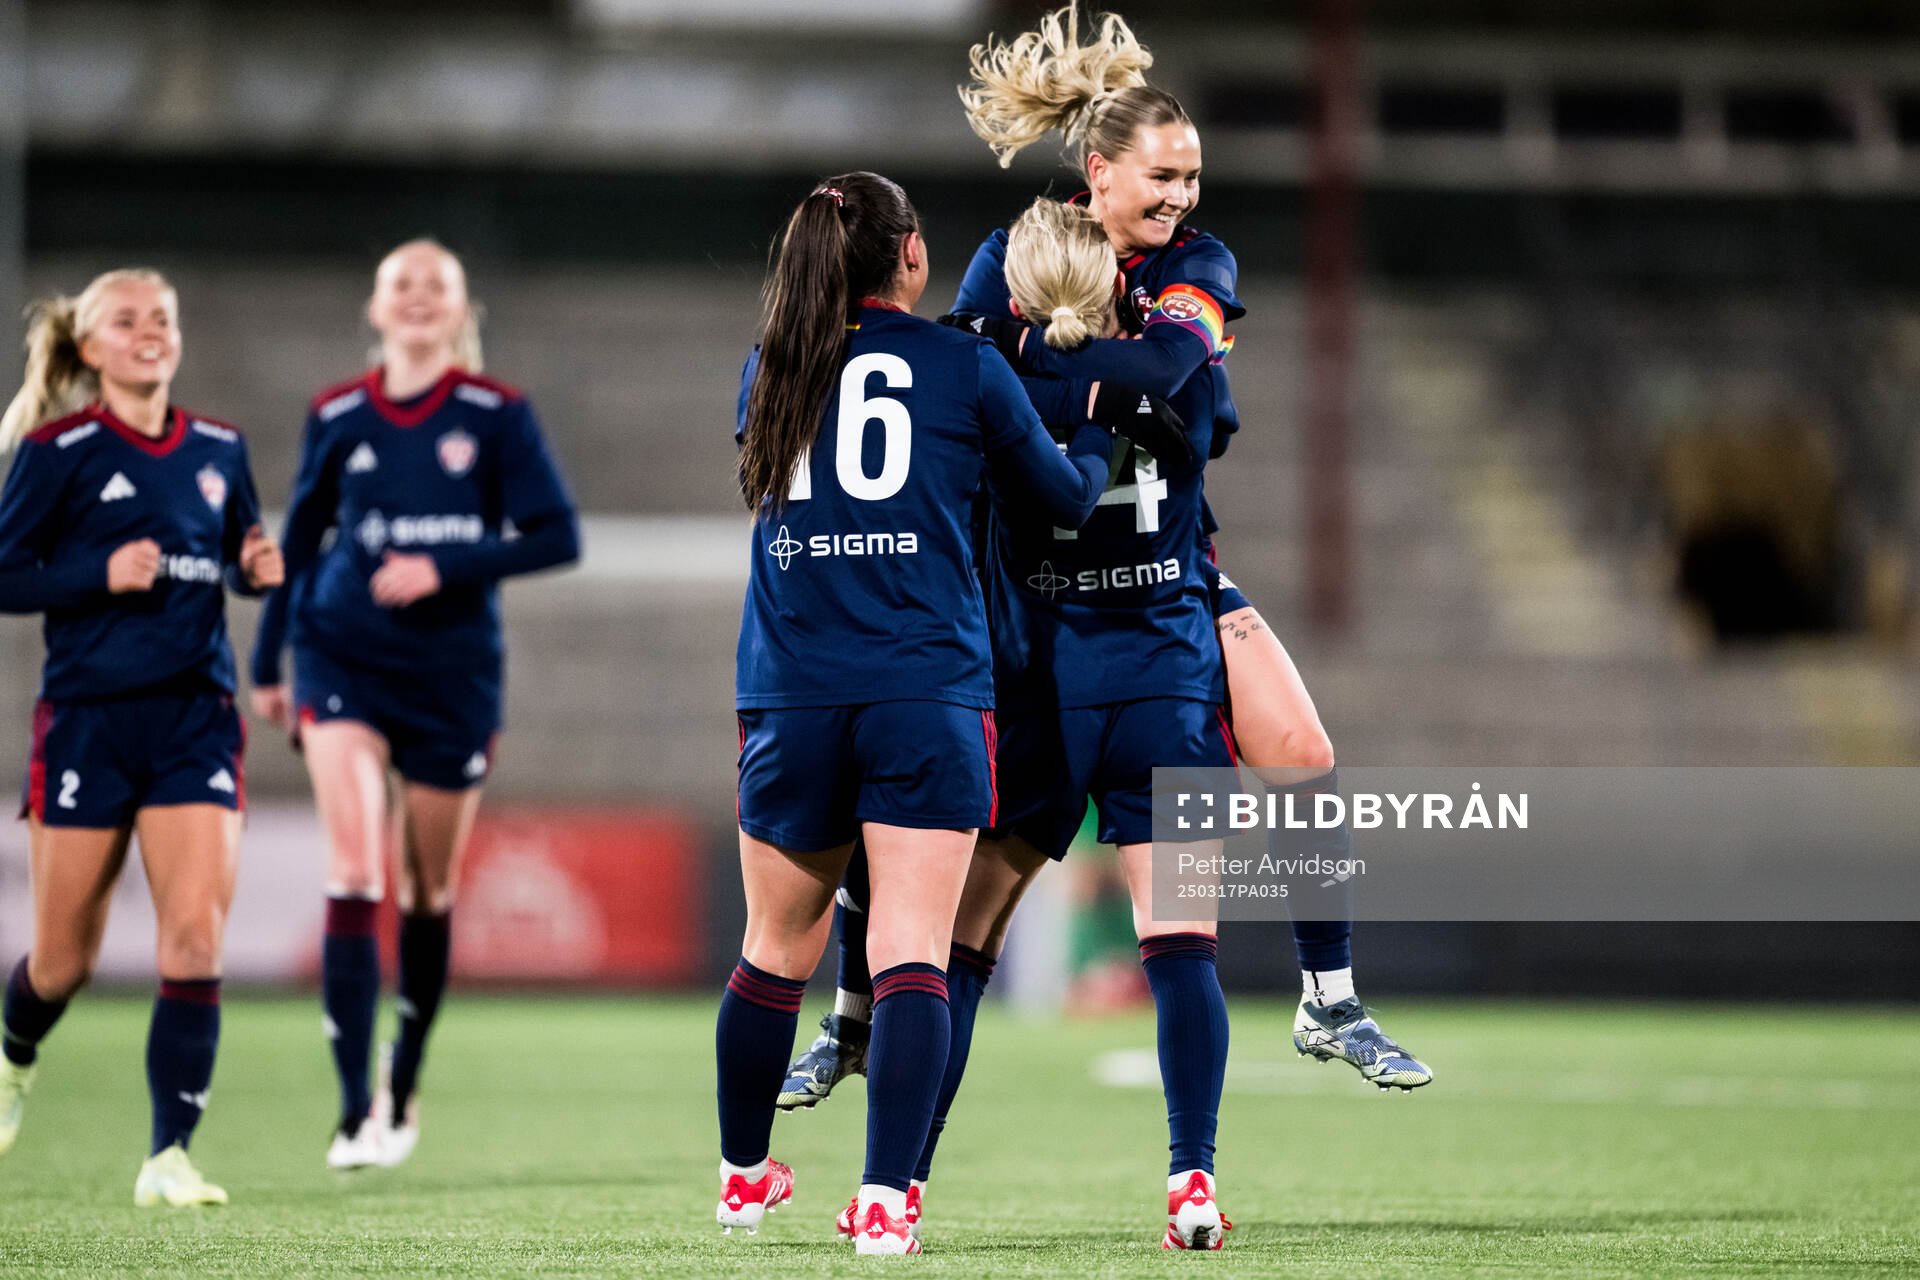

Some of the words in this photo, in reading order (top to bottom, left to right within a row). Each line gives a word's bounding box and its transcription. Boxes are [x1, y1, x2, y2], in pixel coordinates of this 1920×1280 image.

[1164, 299, 1199, 314] FCR
[1053, 432, 1168, 540] 4
[57, 768, 80, 809] 2
